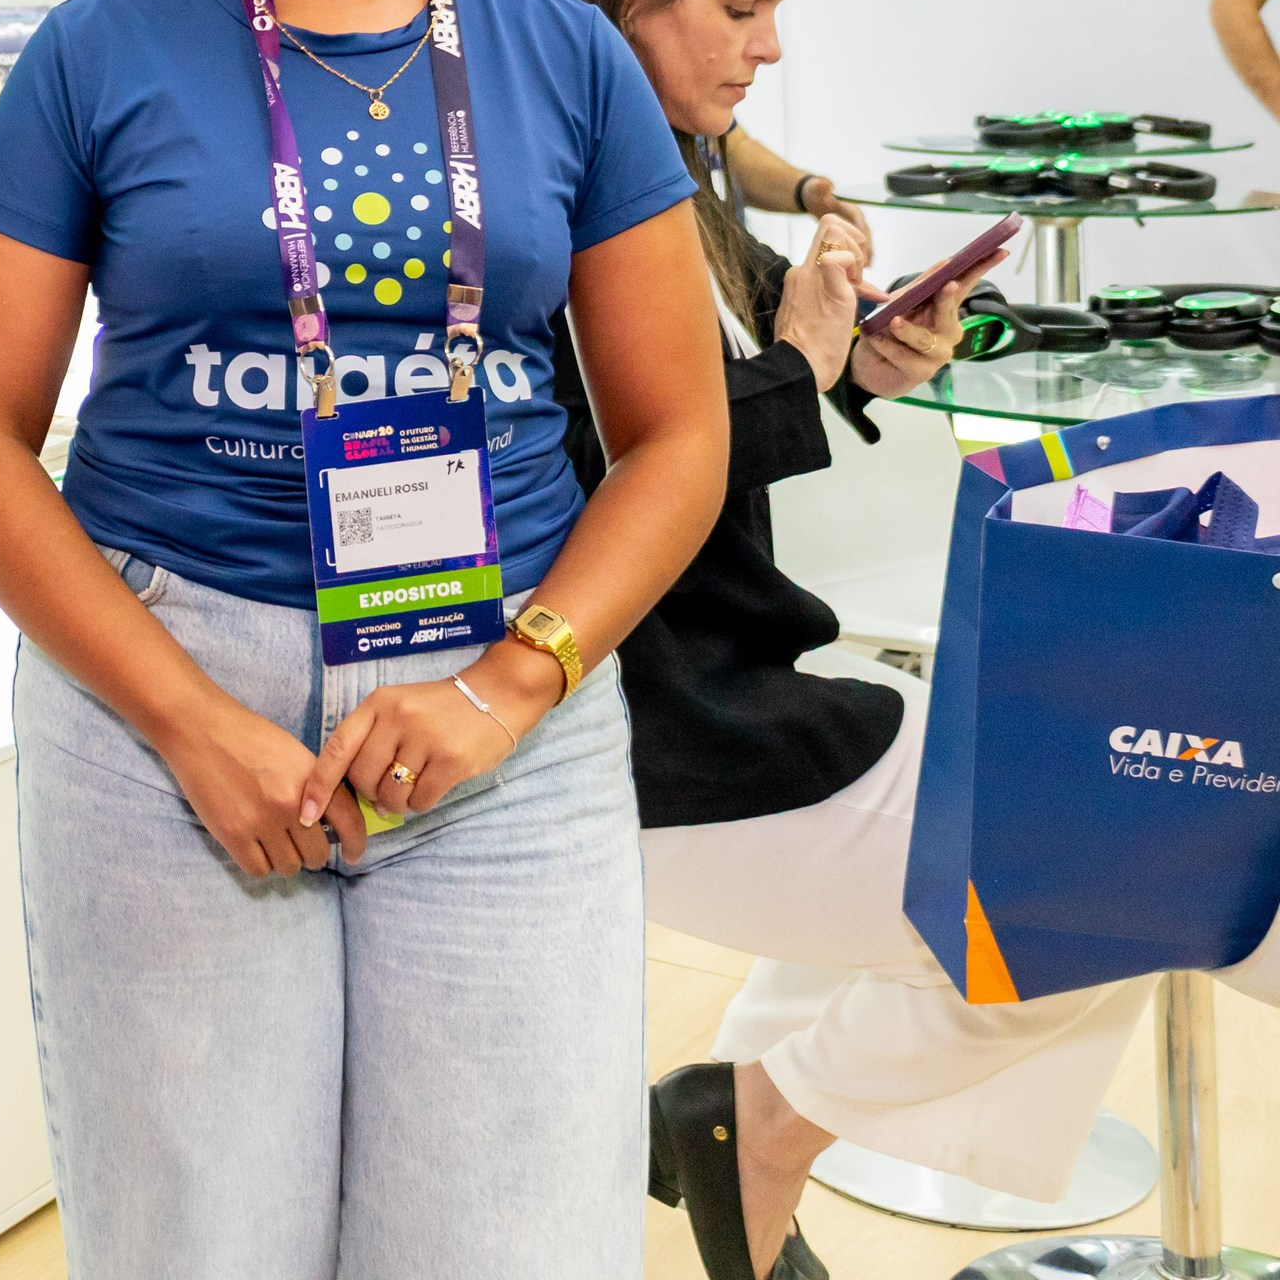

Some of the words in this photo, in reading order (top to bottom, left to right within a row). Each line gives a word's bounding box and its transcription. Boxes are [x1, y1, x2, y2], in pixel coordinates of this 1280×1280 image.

[447, 110, 460, 153] REFERÊNCIA
[454, 116, 468, 153] HUMANA
[273, 163, 307, 230] ABRH
[449, 161, 481, 230] ABRH
[288, 240, 300, 285] HUMANA
[297, 239, 309, 291] REFERÊNCIA
[406, 426, 435, 436] FUTURO
[411, 434, 438, 444] GESTÃO
[335, 486, 393, 503] EMANUELI
[394, 481, 429, 495] ROSSI
[359, 581, 463, 609] EXPOSITOR
[356, 622, 402, 635] PATROCÍNIO
[418, 612, 465, 626] REALIZAÇÃO
[1109, 725, 1244, 769] CAIXA
[1109, 754, 1162, 780] Vida
[1169, 769, 1184, 783] e
